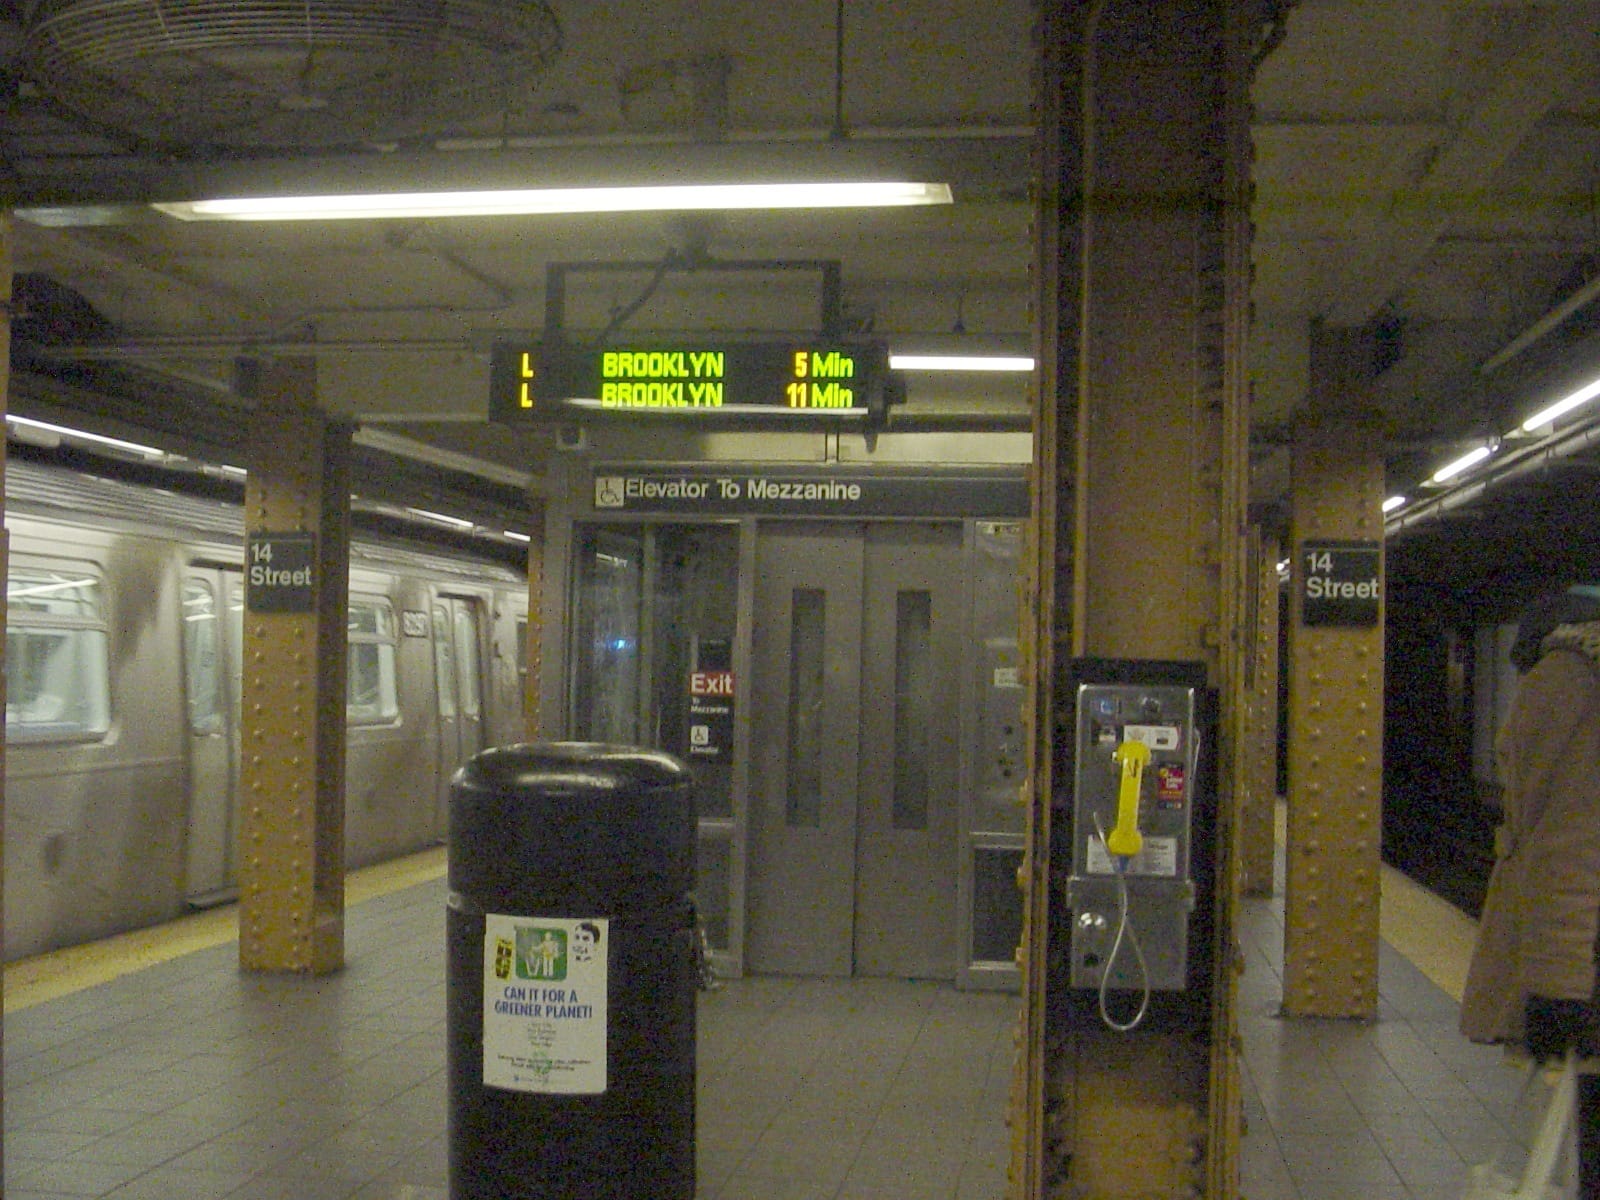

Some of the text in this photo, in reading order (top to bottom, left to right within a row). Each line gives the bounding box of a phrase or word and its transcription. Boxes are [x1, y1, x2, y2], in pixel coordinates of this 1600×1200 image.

[522, 352, 855, 378] L BROOKLYN 5 Min
[520, 382, 854, 408] L BROOKLYN 11 Min
[625, 480, 862, 501] Elevator To Mezzanine
[251, 543, 272, 562] 14
[1307, 552, 1333, 573] 14
[250, 566, 312, 586] Street
[1306, 576, 1379, 599] Street
[691, 673, 732, 694] Exit
[504, 986, 579, 1003] CAN IT FOR A
[494, 1000, 593, 1019] GREENER PLANET!
